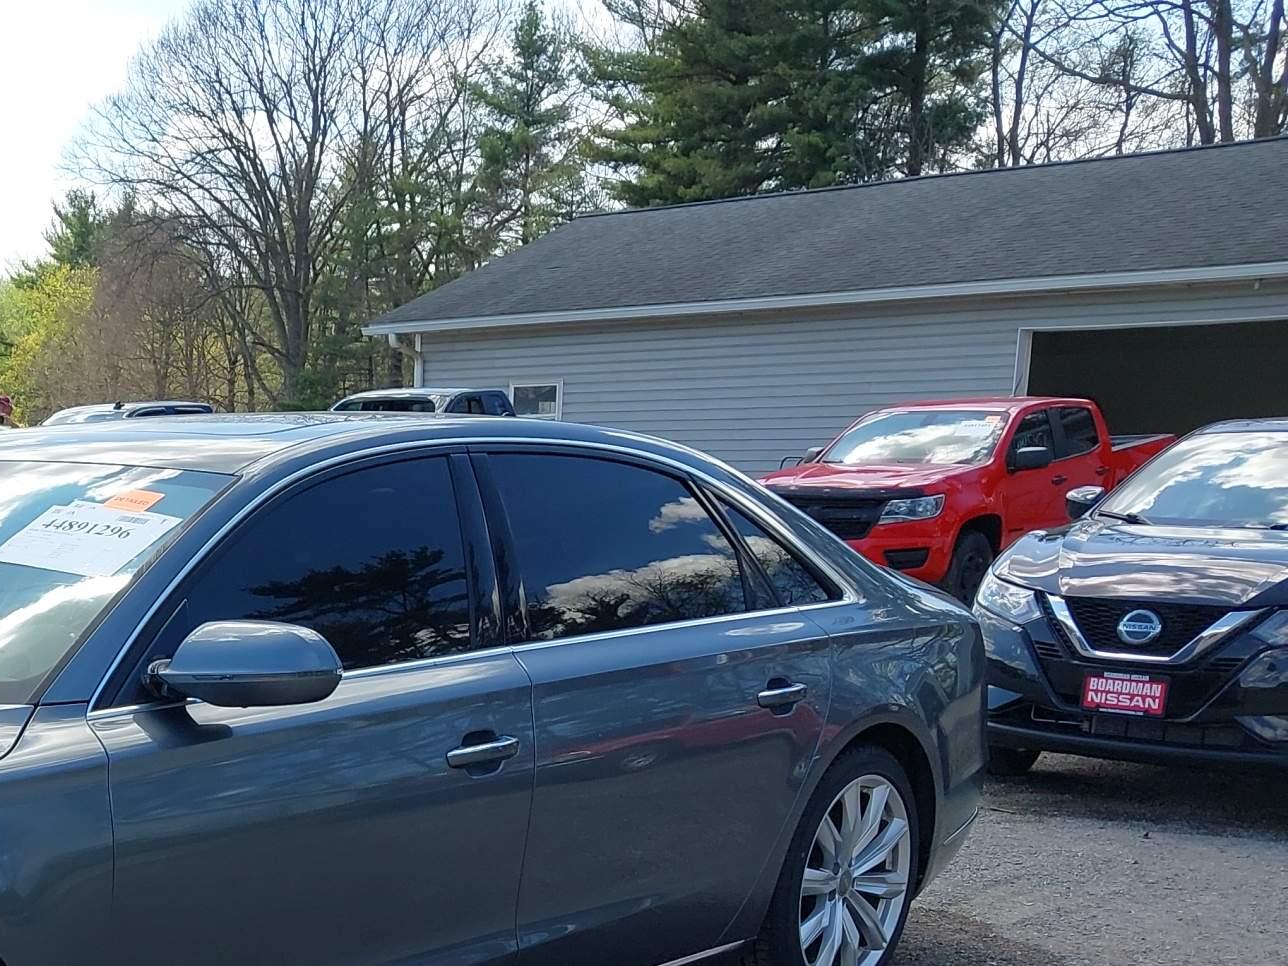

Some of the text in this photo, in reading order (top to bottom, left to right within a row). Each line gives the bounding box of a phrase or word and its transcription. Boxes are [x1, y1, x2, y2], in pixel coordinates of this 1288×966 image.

[42, 518, 134, 539] 44891296
[1123, 623, 1156, 631] NISSAN
[1090, 677, 1161, 697] BOARDMAN
[1088, 692, 1159, 709] NISSAN
